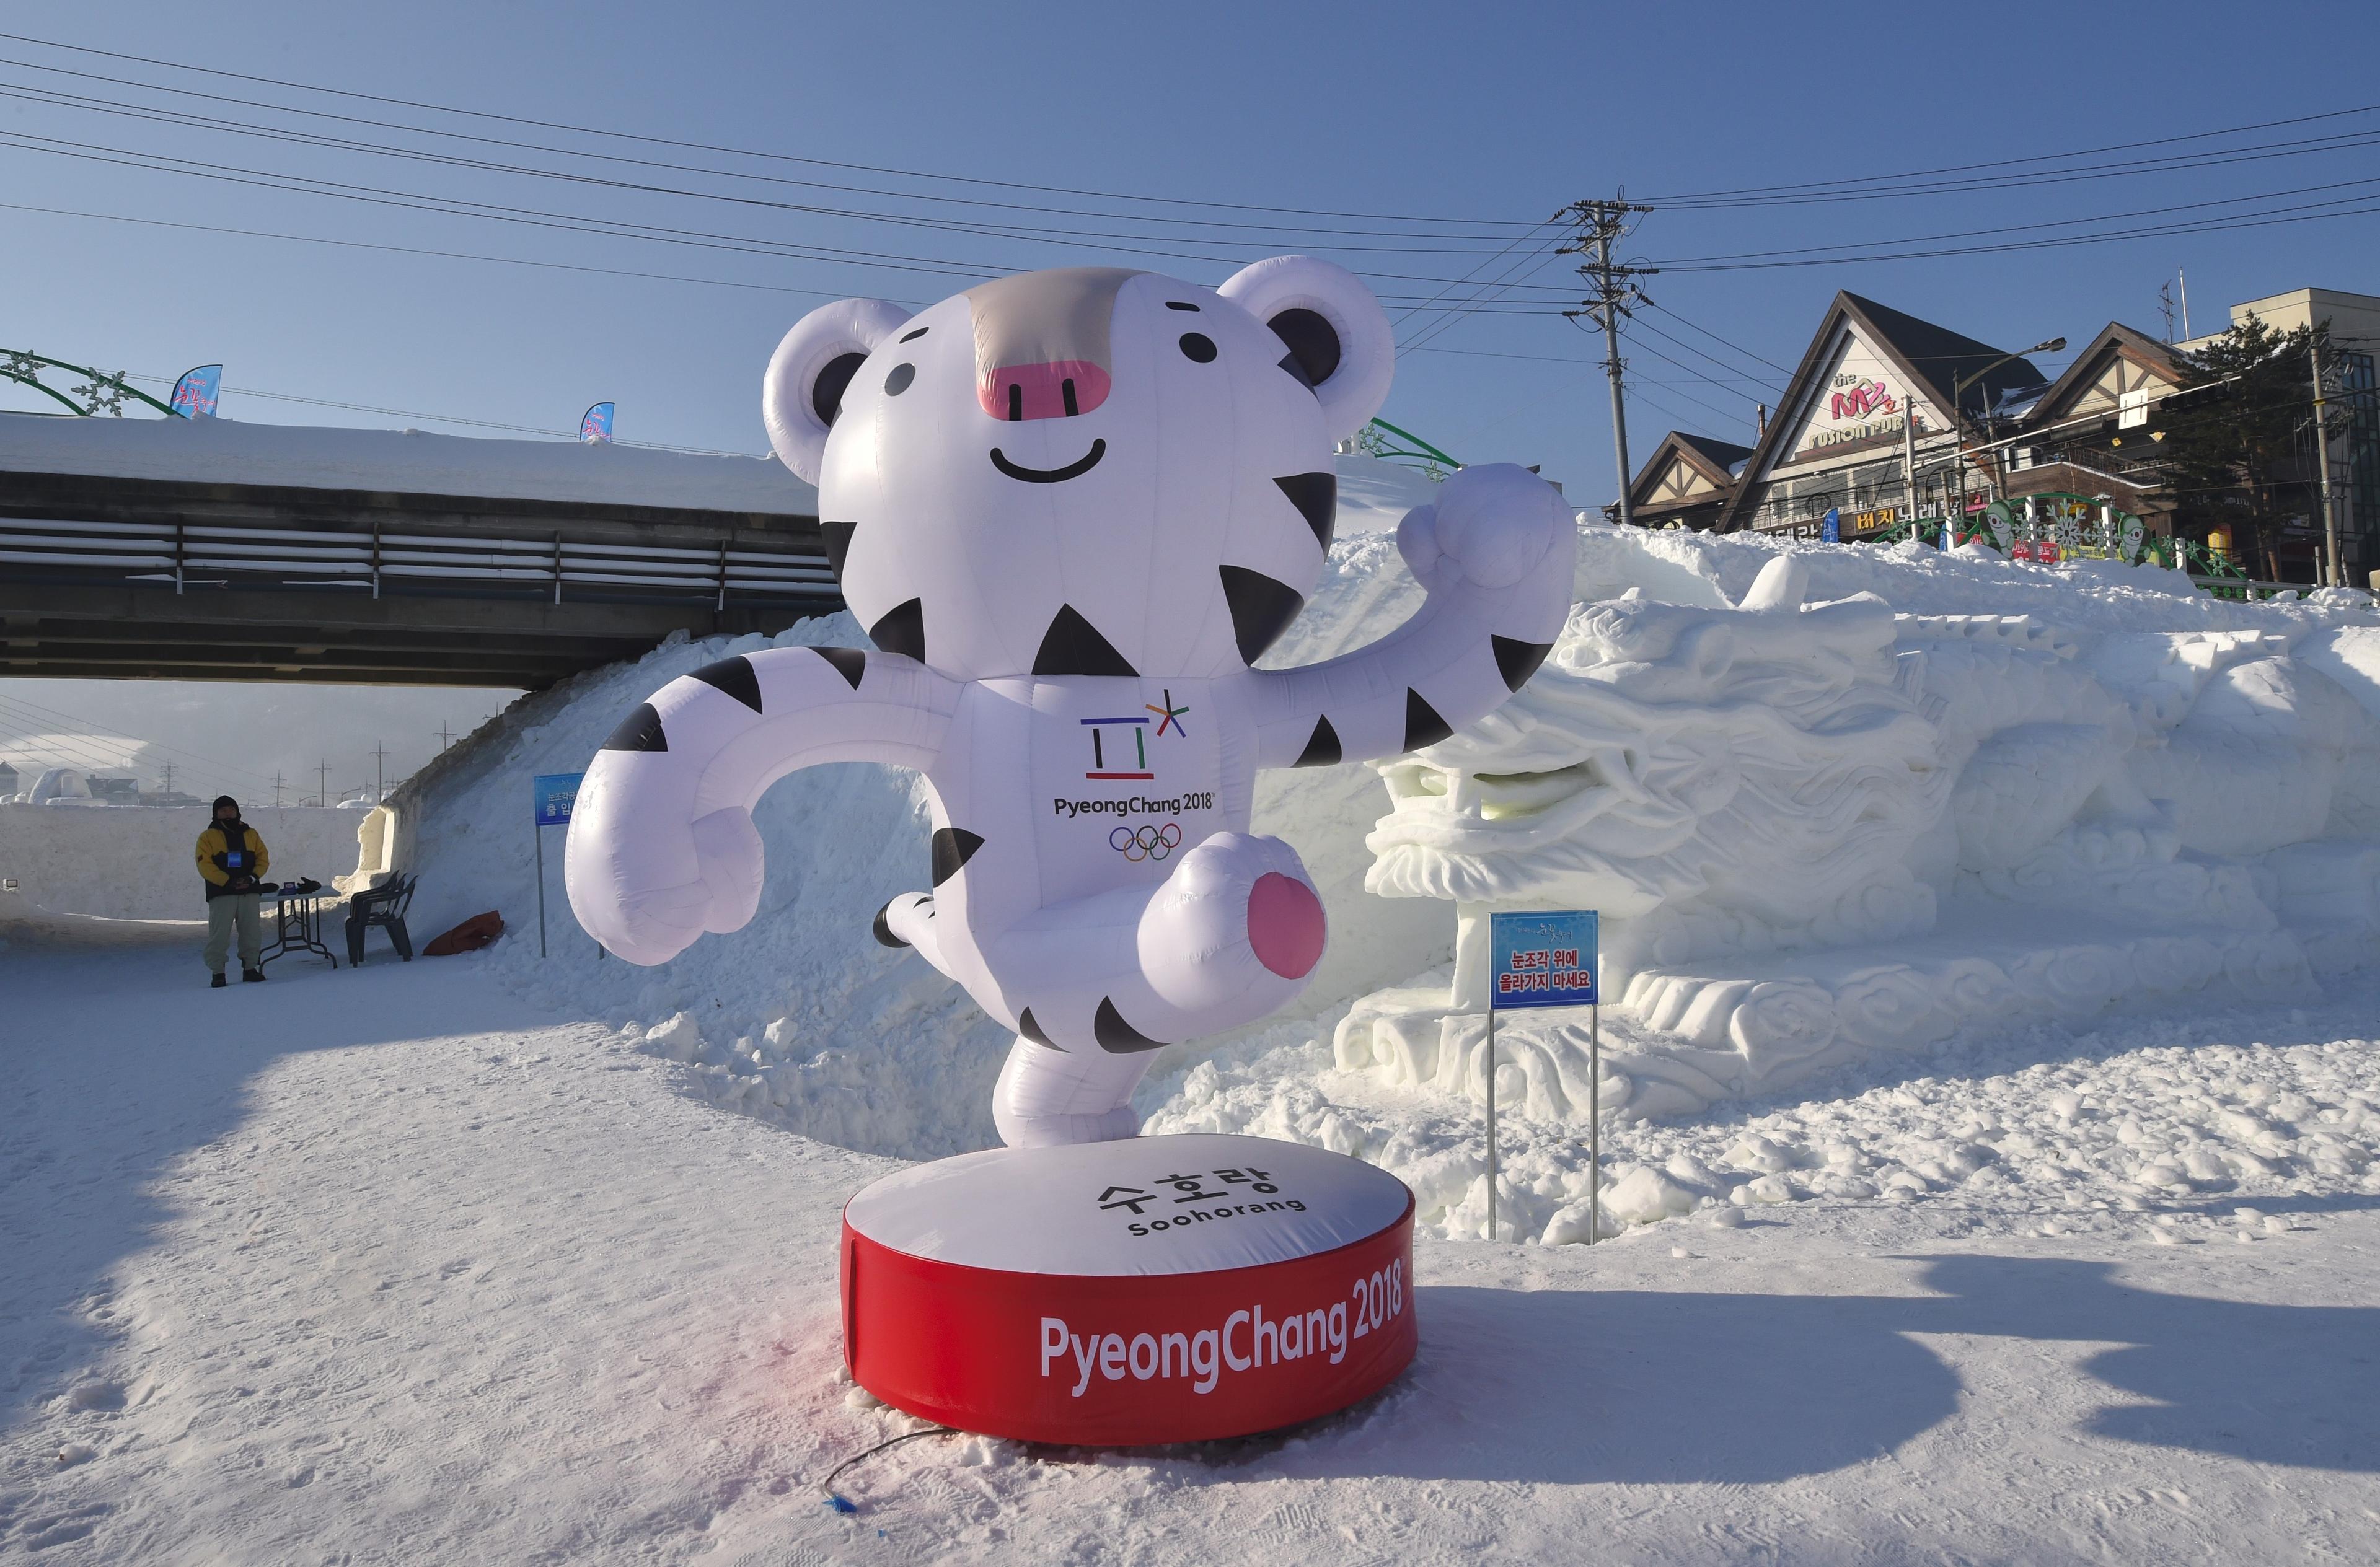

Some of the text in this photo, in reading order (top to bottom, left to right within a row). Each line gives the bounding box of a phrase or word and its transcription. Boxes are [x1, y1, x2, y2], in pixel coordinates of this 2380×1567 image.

[1834, 373, 1856, 387] the
[1809, 424, 1866, 449] FUSION
[1870, 416, 1905, 436] PUB
[548, 791, 577, 802] 눈조각공
[1054, 792, 1212, 818] PyeongChang 2018
[1512, 950, 1577, 968] 눈조각 위에
[1499, 971, 1590, 991] 올라가지 마세요
[1097, 1167, 1279, 1214] 수호랑
[1128, 1200, 1307, 1236] Soohorang
[1041, 1258, 1402, 1398] PyeongChang 2018
